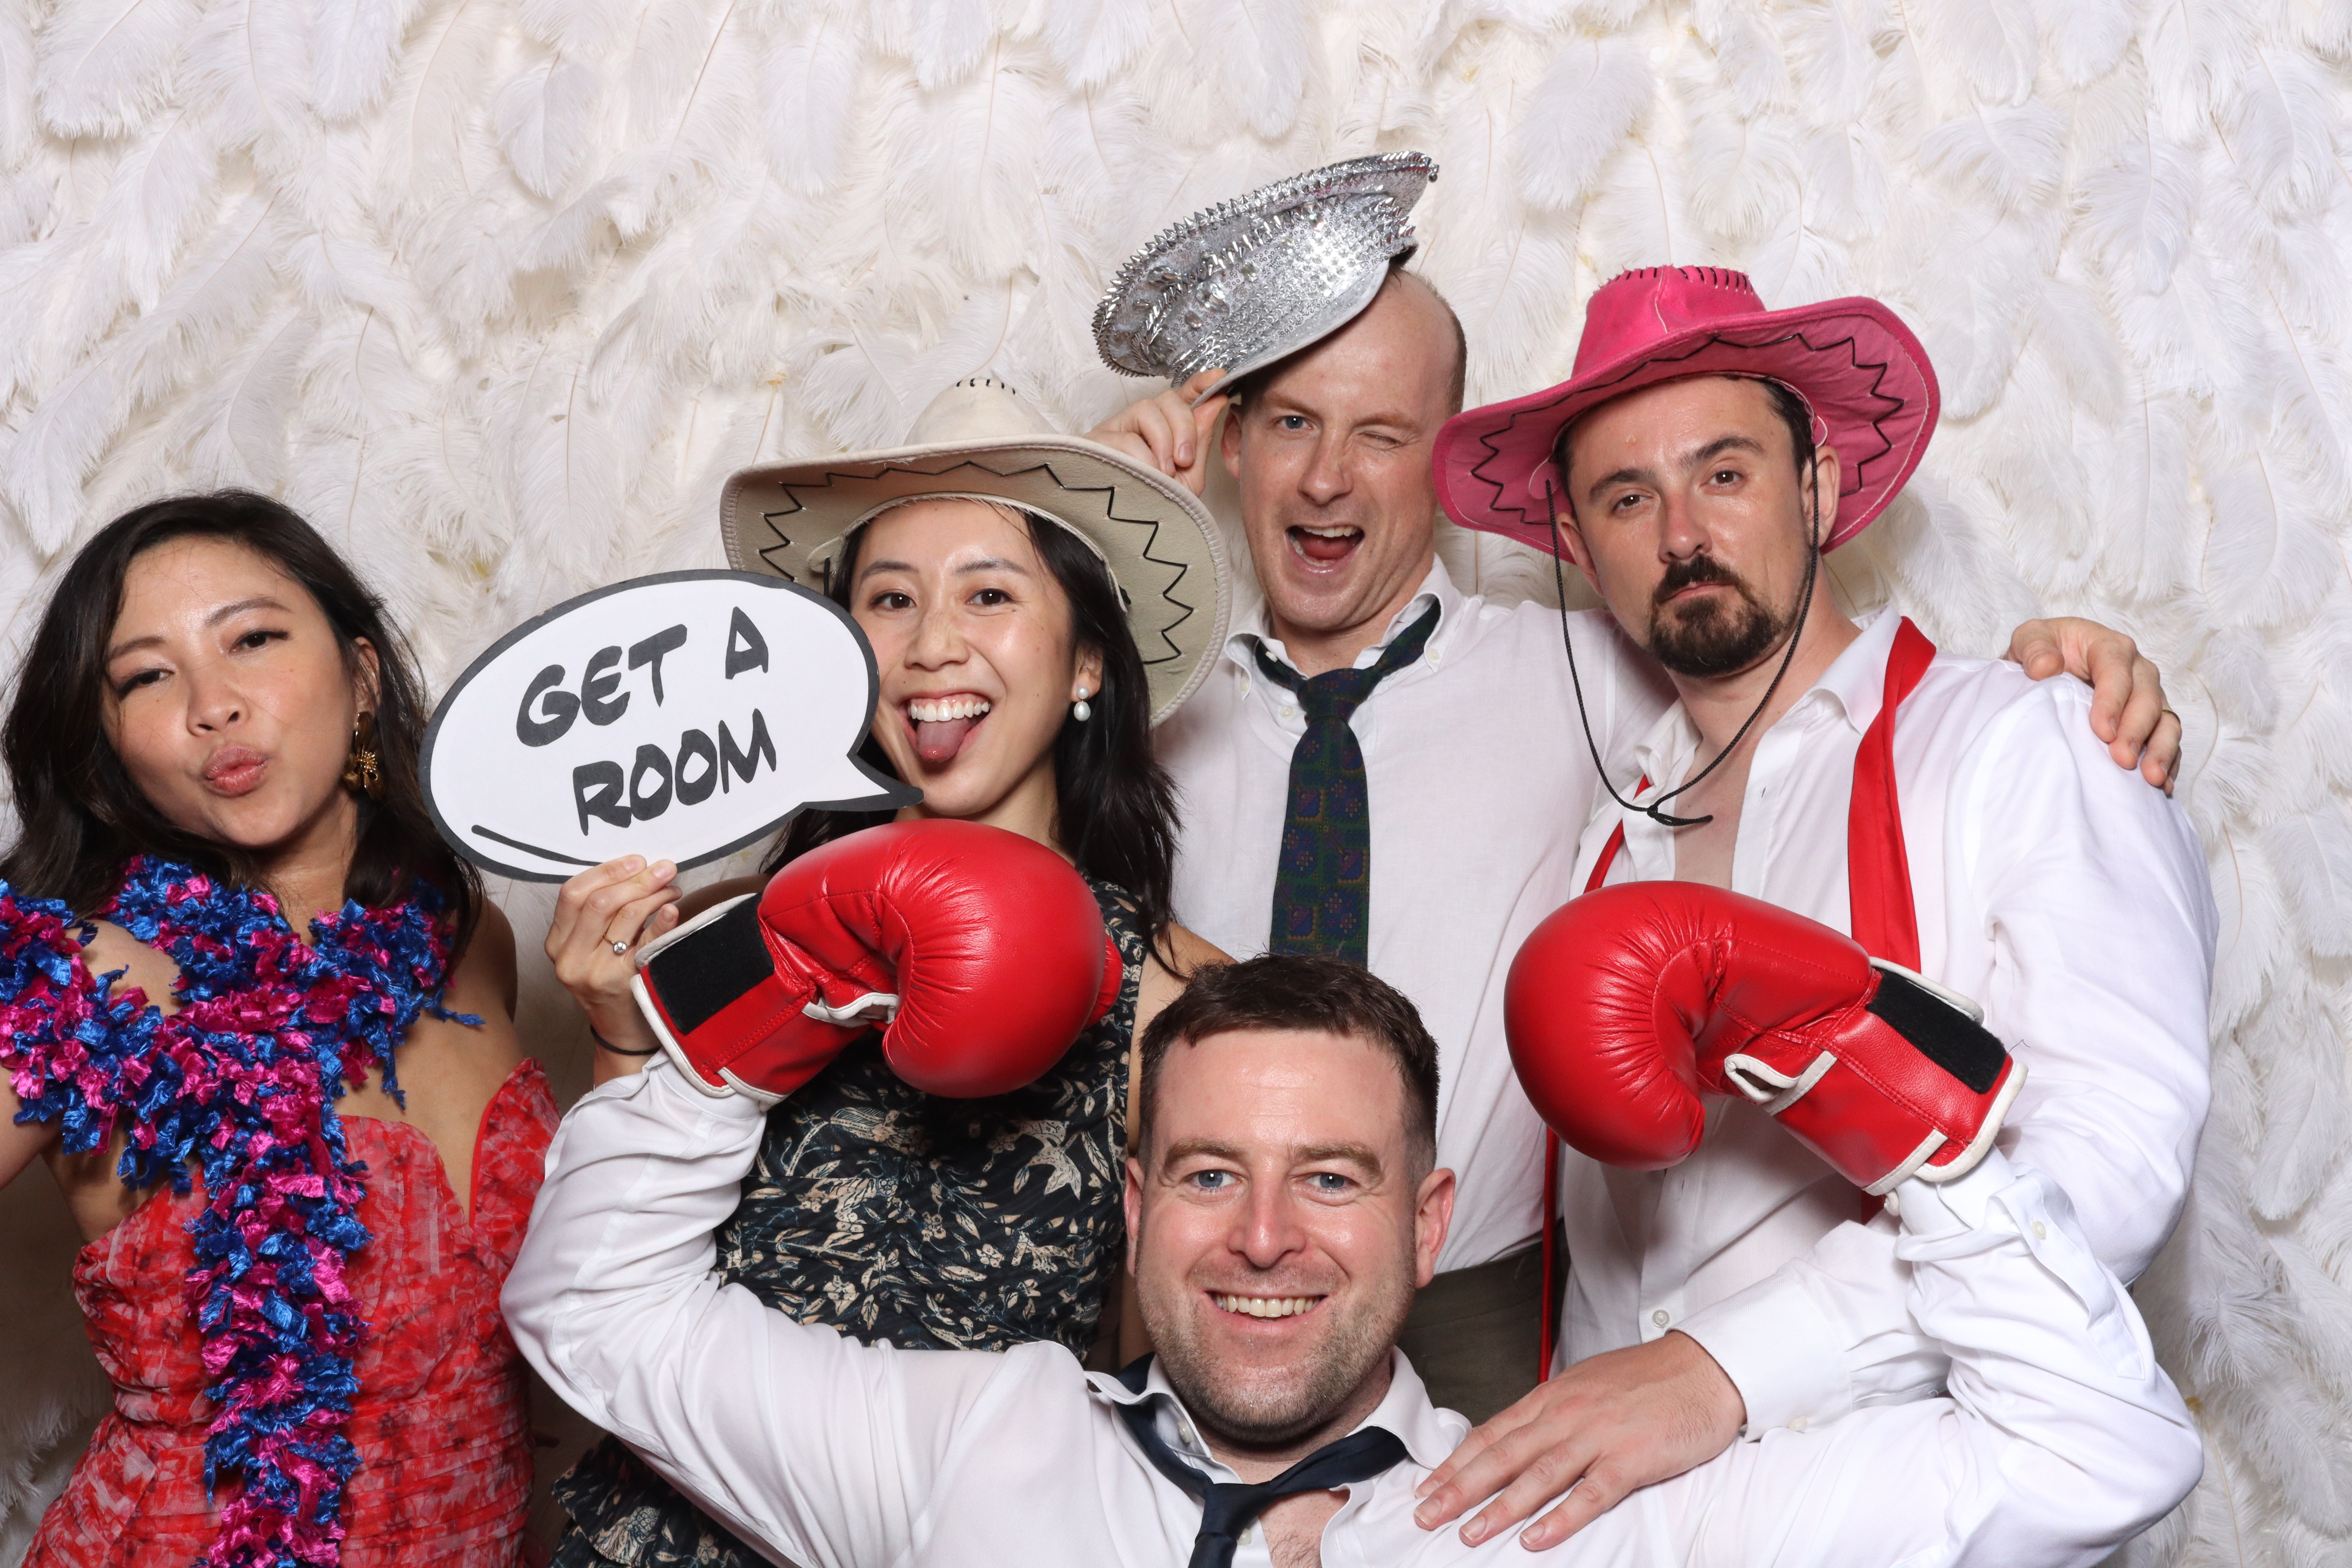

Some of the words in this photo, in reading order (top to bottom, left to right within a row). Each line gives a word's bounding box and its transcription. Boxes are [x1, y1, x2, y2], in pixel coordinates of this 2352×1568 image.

[516, 624, 688, 747] GET
[725, 606, 769, 680] A
[572, 708, 777, 836] ROOM
